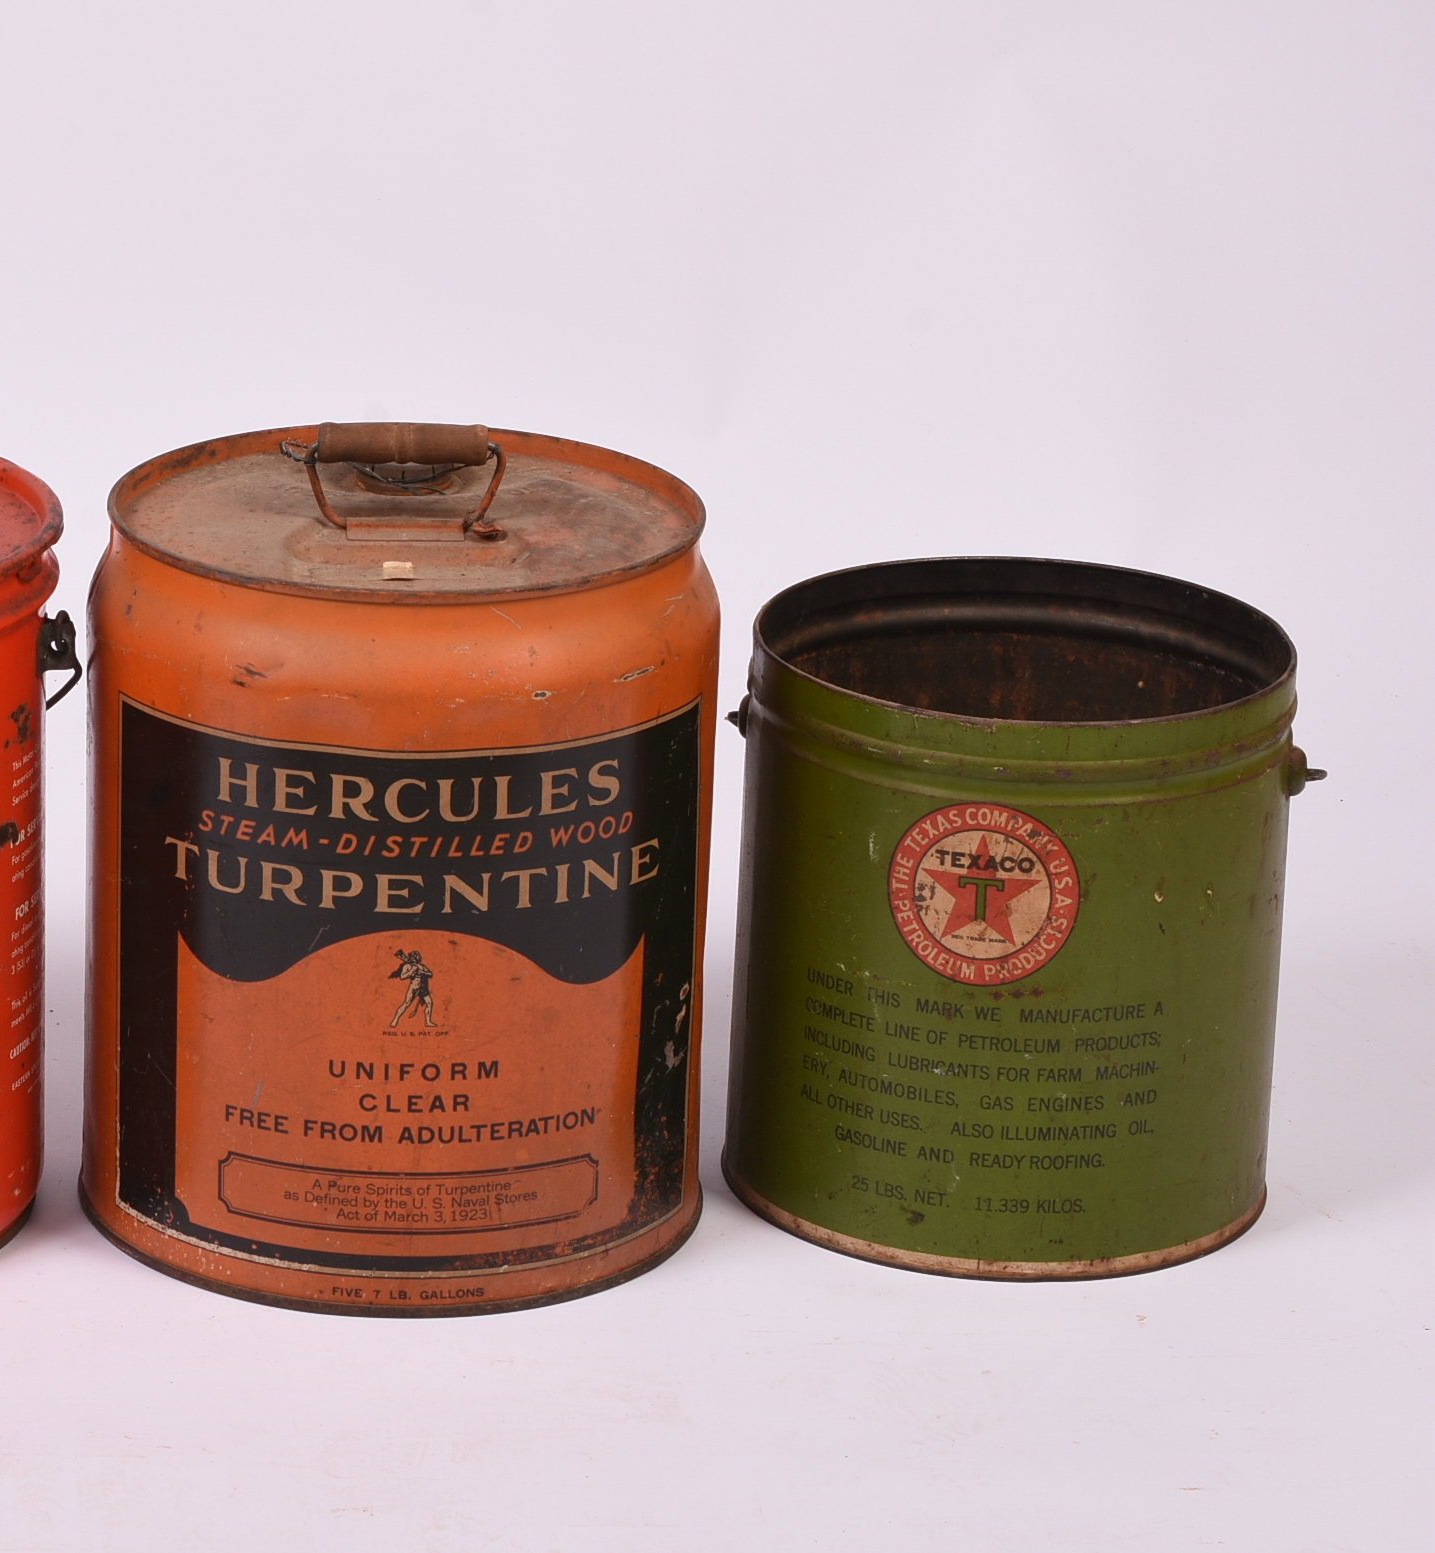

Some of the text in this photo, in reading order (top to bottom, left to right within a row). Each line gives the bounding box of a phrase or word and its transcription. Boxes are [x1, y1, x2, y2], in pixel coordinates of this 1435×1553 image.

[216, 755, 621, 824] HERCULES
[198, 808, 635, 859] STEAM-DISTILLED WOOD
[892, 852, 915, 890] THE
[904, 809, 963, 852] TEXAS
[164, 835, 661, 916] TURPENTINE
[934, 849, 1036, 874] TEXACO
[15, 900, 30, 920] FOR
[958, 875, 1006, 923] T
[893, 898, 1068, 981] PETROLEUM PRODUCTS
[807, 966, 1164, 1024] UNDER THIS MARK WE MANUFACTURE A
[805, 997, 1162, 1054] COMPLETE LINE OF PETROLEUM PRODUCTS;
[328, 1058, 500, 1082] UNIFORM
[804, 1025, 1160, 1083] INCLUDING LUBRICANTS FOR FARM MACHIN-
[358, 1093, 471, 1113] CLEAR
[802, 1054, 1158, 1112] ERY, AUTOMOBILES, GAS ENGINES AND
[224, 1104, 596, 1145] FREE FROM ADULTERATION
[800, 1084, 1155, 1142] ALL OTHER USES. ALSO ILLUMINATING OIL,
[834, 1125, 1106, 1170] GASOLINE AND READY ROOFING.
[283, 1191, 300, 1202] as
[304, 1191, 359, 1208] Defined
[362, 1196, 380, 1211] by
[384, 1197, 408, 1210] the
[451, 1194, 491, 1209] Naval
[494, 1189, 539, 1207] Stores
[312, 1179, 513, 1200] A Pure Spirits of Turpentine
[851, 1175, 1086, 1214] 25 LBS. NET. 11.339 KILOS.
[335, 1208, 489, 1225] Act of March 3, 1923
[332, 1286, 486, 1300] FIVE 7 LB. GALLONS
